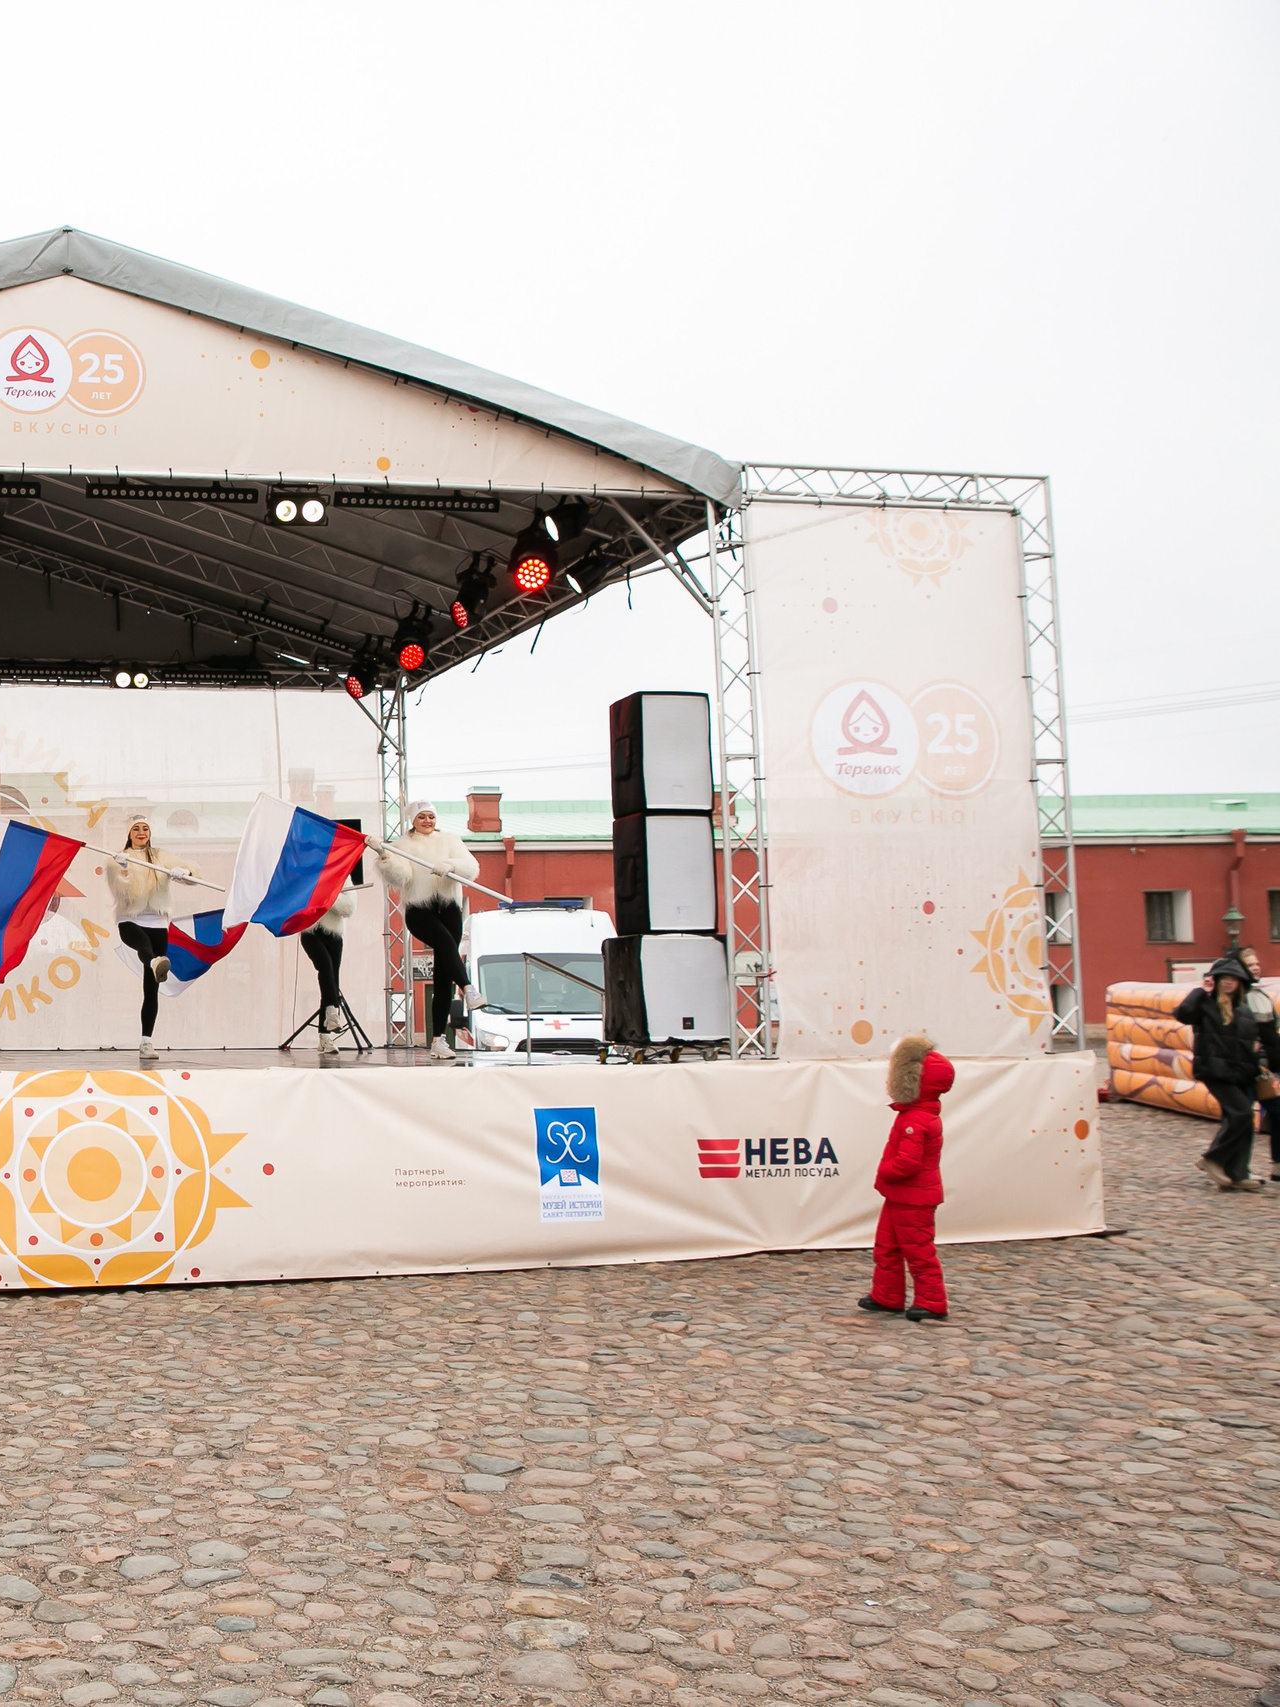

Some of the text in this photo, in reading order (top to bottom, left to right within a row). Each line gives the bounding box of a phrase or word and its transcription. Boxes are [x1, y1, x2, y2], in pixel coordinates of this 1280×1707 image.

[78, 352, 125, 385] 25
[4, 386, 56, 399] Теремок
[91, 391, 112, 400] ЛЕТ
[924, 712, 979, 755] 25
[835, 762, 902, 778] Теремок
[944, 766, 967, 777] ЛЕТ
[745, 1137, 839, 1165] НЕВА
[395, 1168, 445, 1177] Партнеры
[745, 1167, 840, 1178] МЕТАЛЛ ПОСУДА
[395, 1179, 466, 1188] мероприятия:
[542, 1200, 602, 1210] МУЗЕЙ ИСТОРИИ
